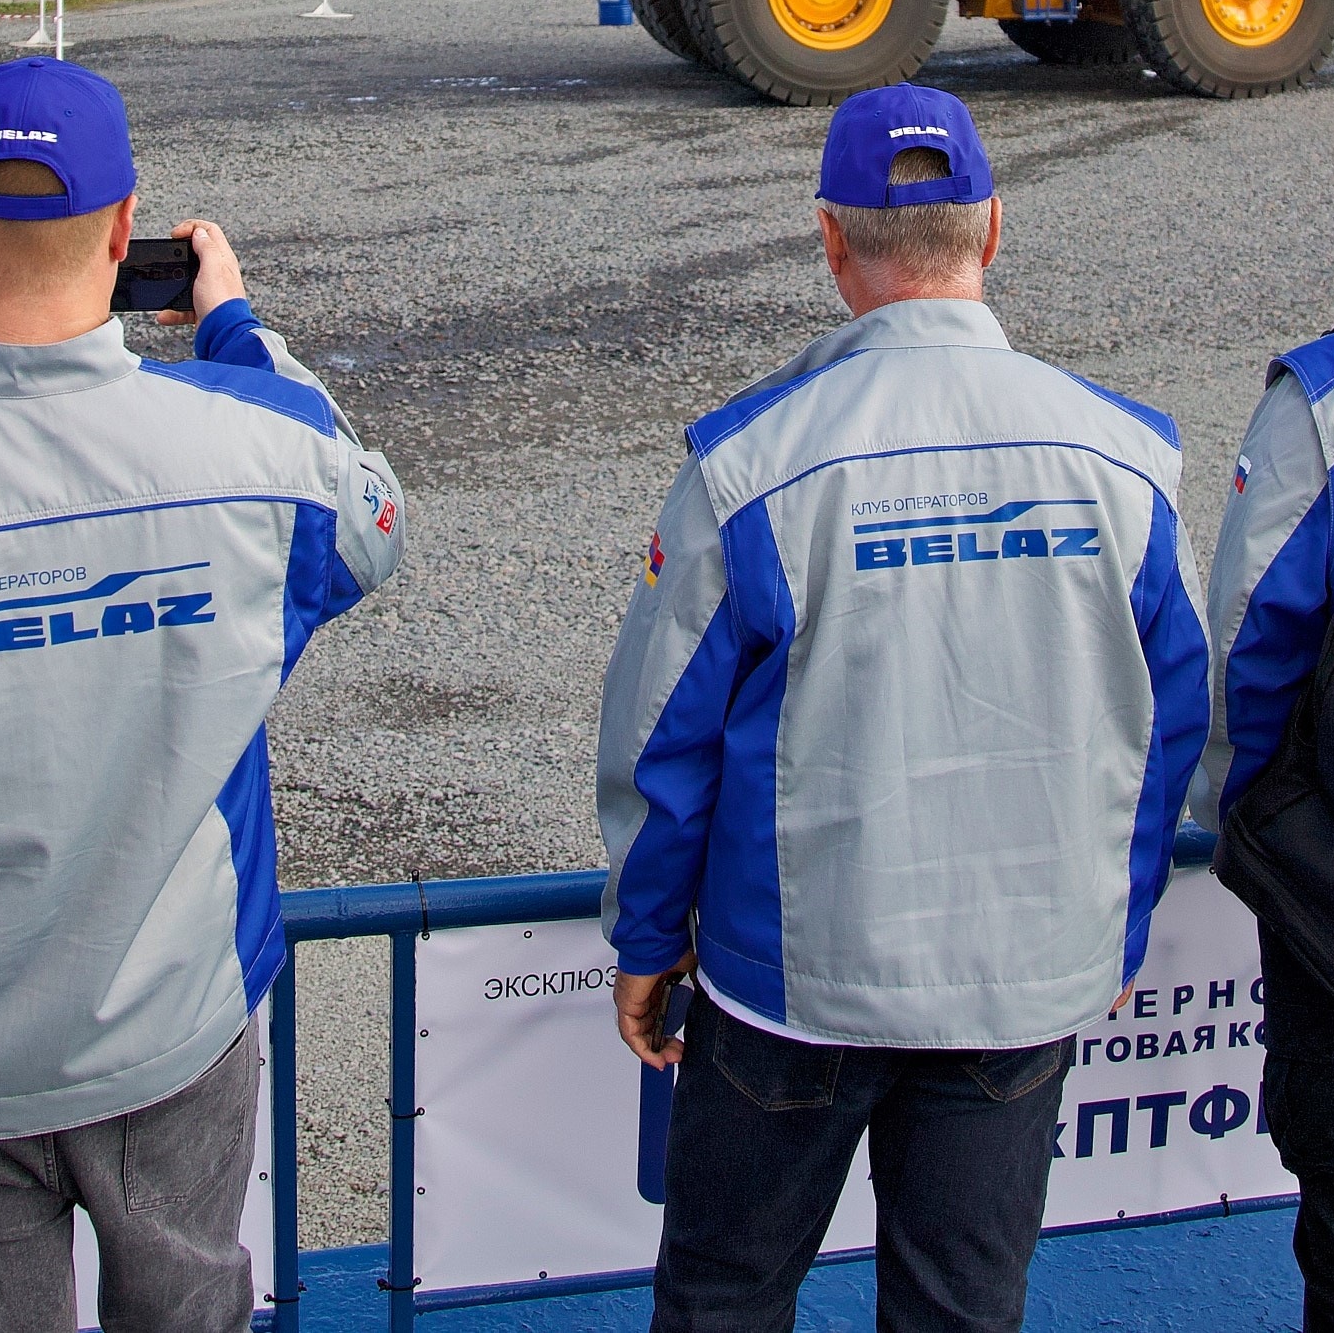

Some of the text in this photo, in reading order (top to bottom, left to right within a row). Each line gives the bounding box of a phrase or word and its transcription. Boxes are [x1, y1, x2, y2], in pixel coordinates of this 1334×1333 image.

[888, 126, 950, 139] BELAZ
[851, 492, 989, 516] КЛУБ ОПЕРАТОРОВ
[855, 528, 1101, 571] BELAZ
[1070, 1025, 1216, 1066] ГОВАЯ
